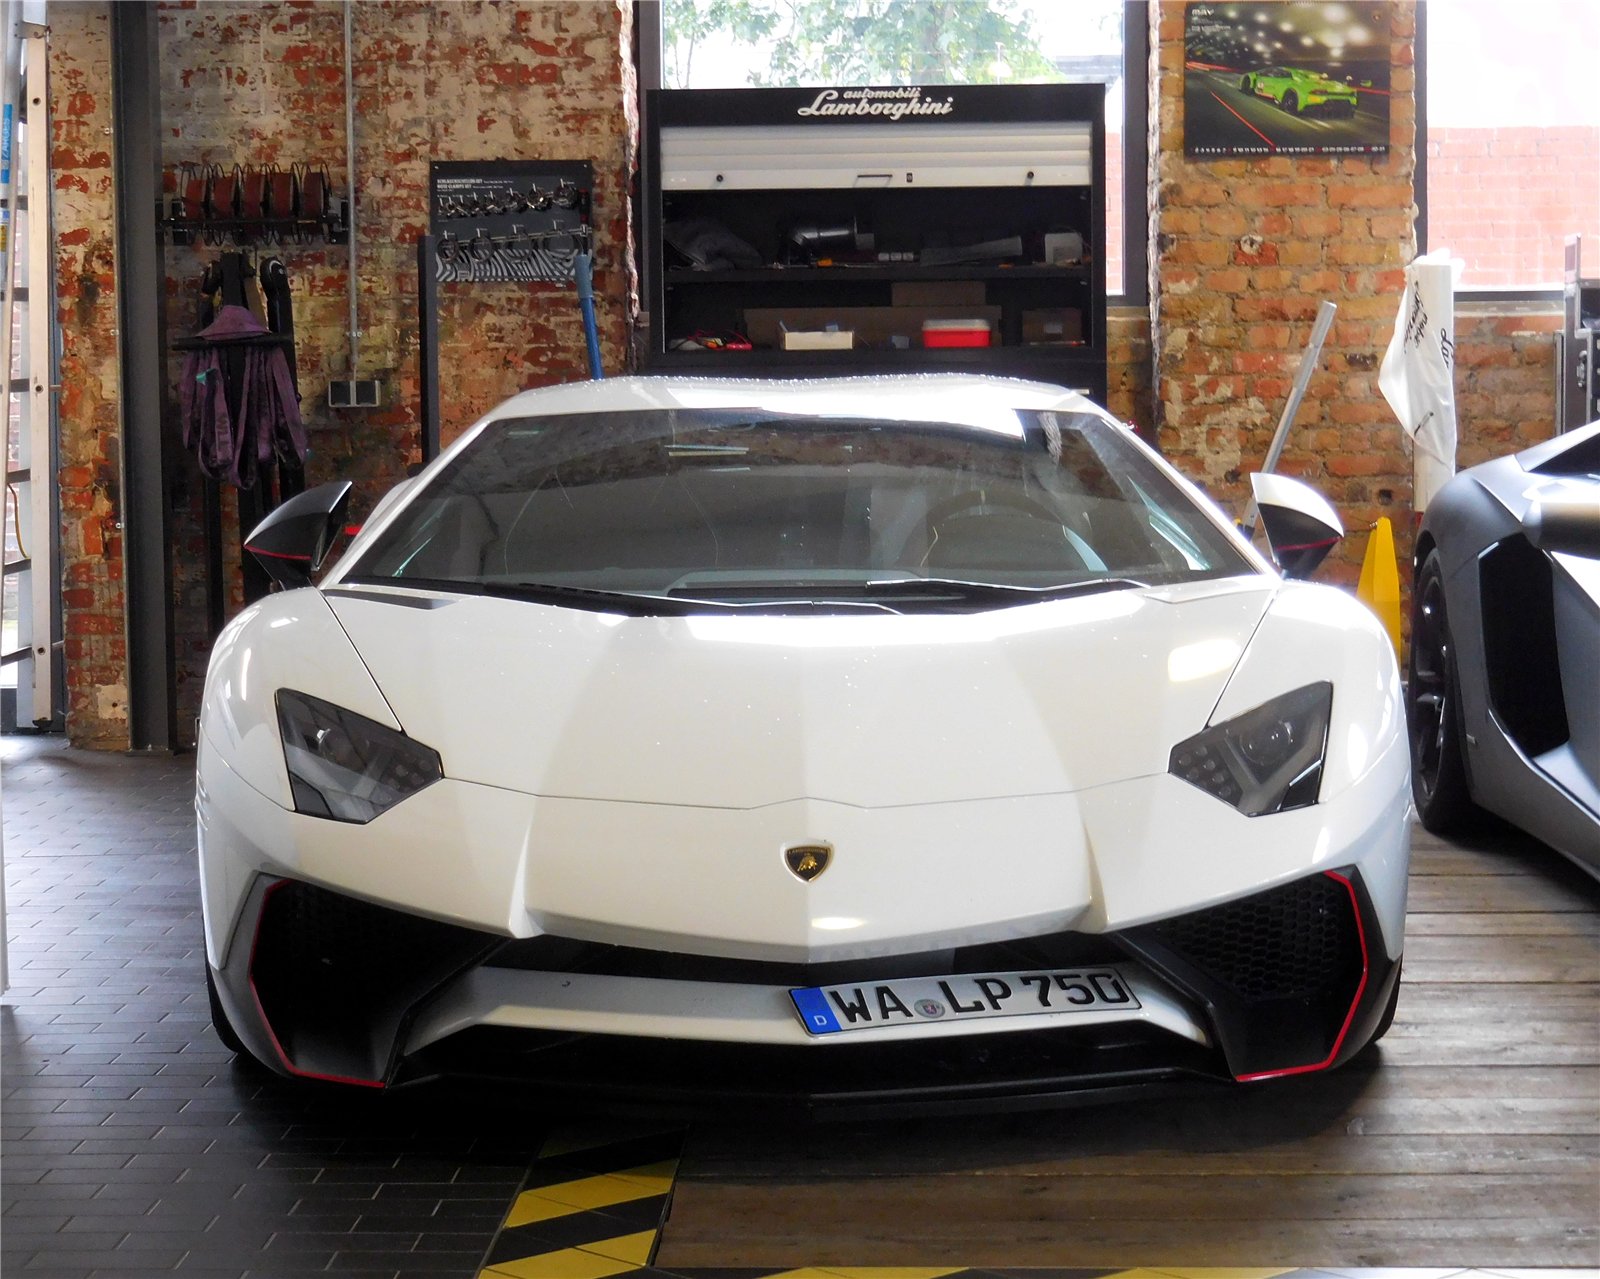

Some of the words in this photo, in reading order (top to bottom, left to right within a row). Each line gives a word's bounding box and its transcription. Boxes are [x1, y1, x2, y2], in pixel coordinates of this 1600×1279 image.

[843, 87, 922, 99] automobili
[797, 89, 954, 120] Lamborghini
[829, 985, 914, 1023] WA
[938, 978, 1014, 1014] LP
[1020, 973, 1131, 1008] 750
[813, 1015, 828, 1026] D
